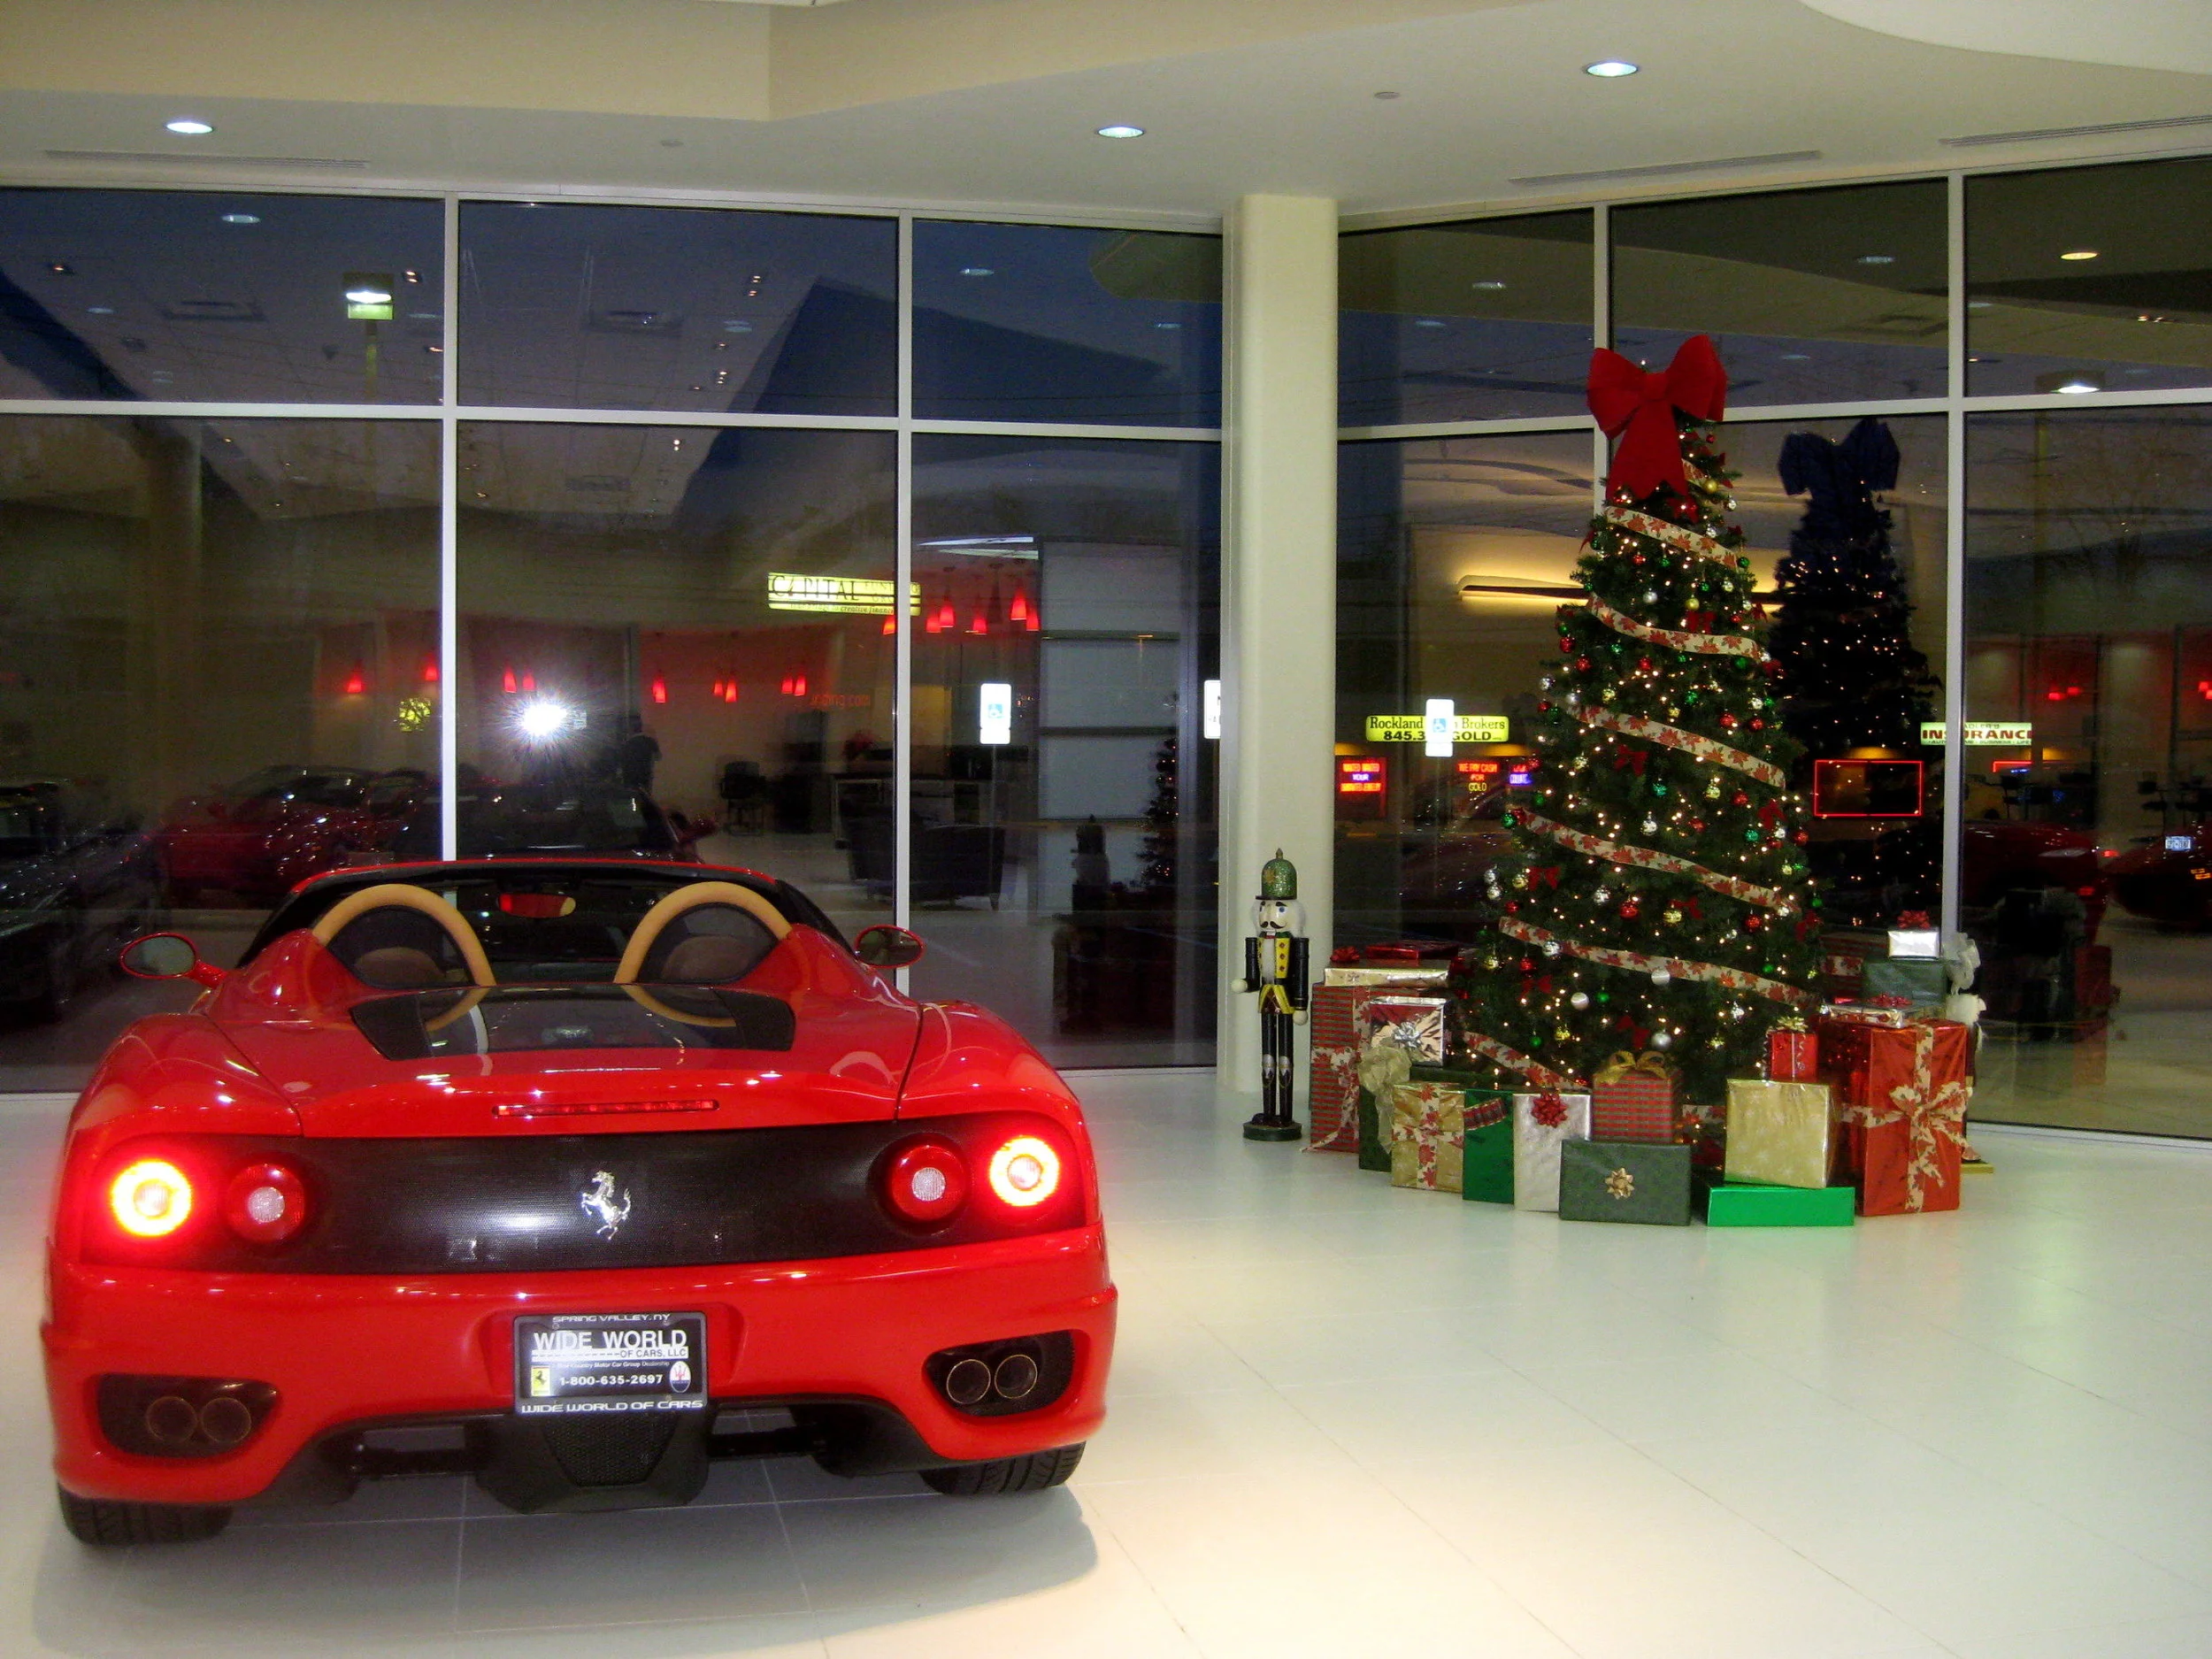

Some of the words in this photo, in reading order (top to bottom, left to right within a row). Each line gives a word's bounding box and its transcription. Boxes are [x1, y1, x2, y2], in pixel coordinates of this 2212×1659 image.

[1370, 716, 1424, 730] Rockland
[1461, 717, 1505, 730] Brokers
[552, 1315, 597, 1324] SPRING
[534, 1332, 593, 1350] WIDE
[603, 1330, 687, 1348] WORLD
[559, 1374, 664, 1386] 1-800-635-2697
[521, 1402, 564, 1414] WIDE
[566, 1402, 628, 1413] WORLD
[631, 1401, 655, 1411] OF
[657, 1399, 703, 1410] CARS
